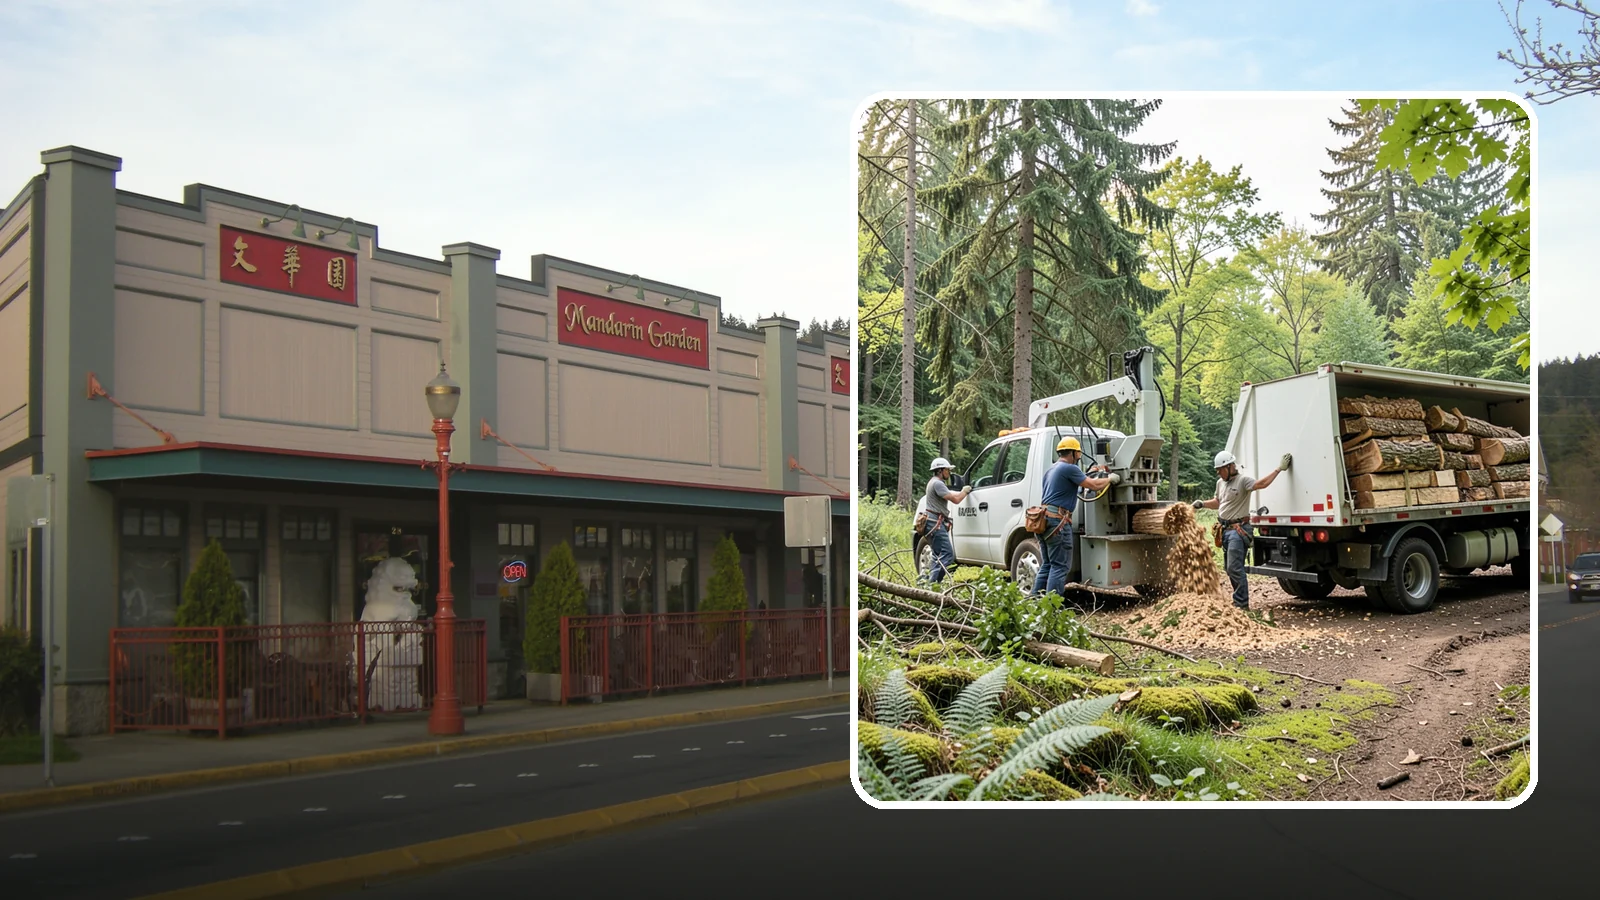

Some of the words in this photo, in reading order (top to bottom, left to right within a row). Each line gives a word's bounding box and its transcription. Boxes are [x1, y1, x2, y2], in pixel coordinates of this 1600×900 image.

[231, 236, 346, 290] 文華園
[564, 302, 644, 341] Mandarin
[648, 320, 702, 352] Garden
[834, 363, 846, 386] 文
[503, 565, 527, 578] OPEN
